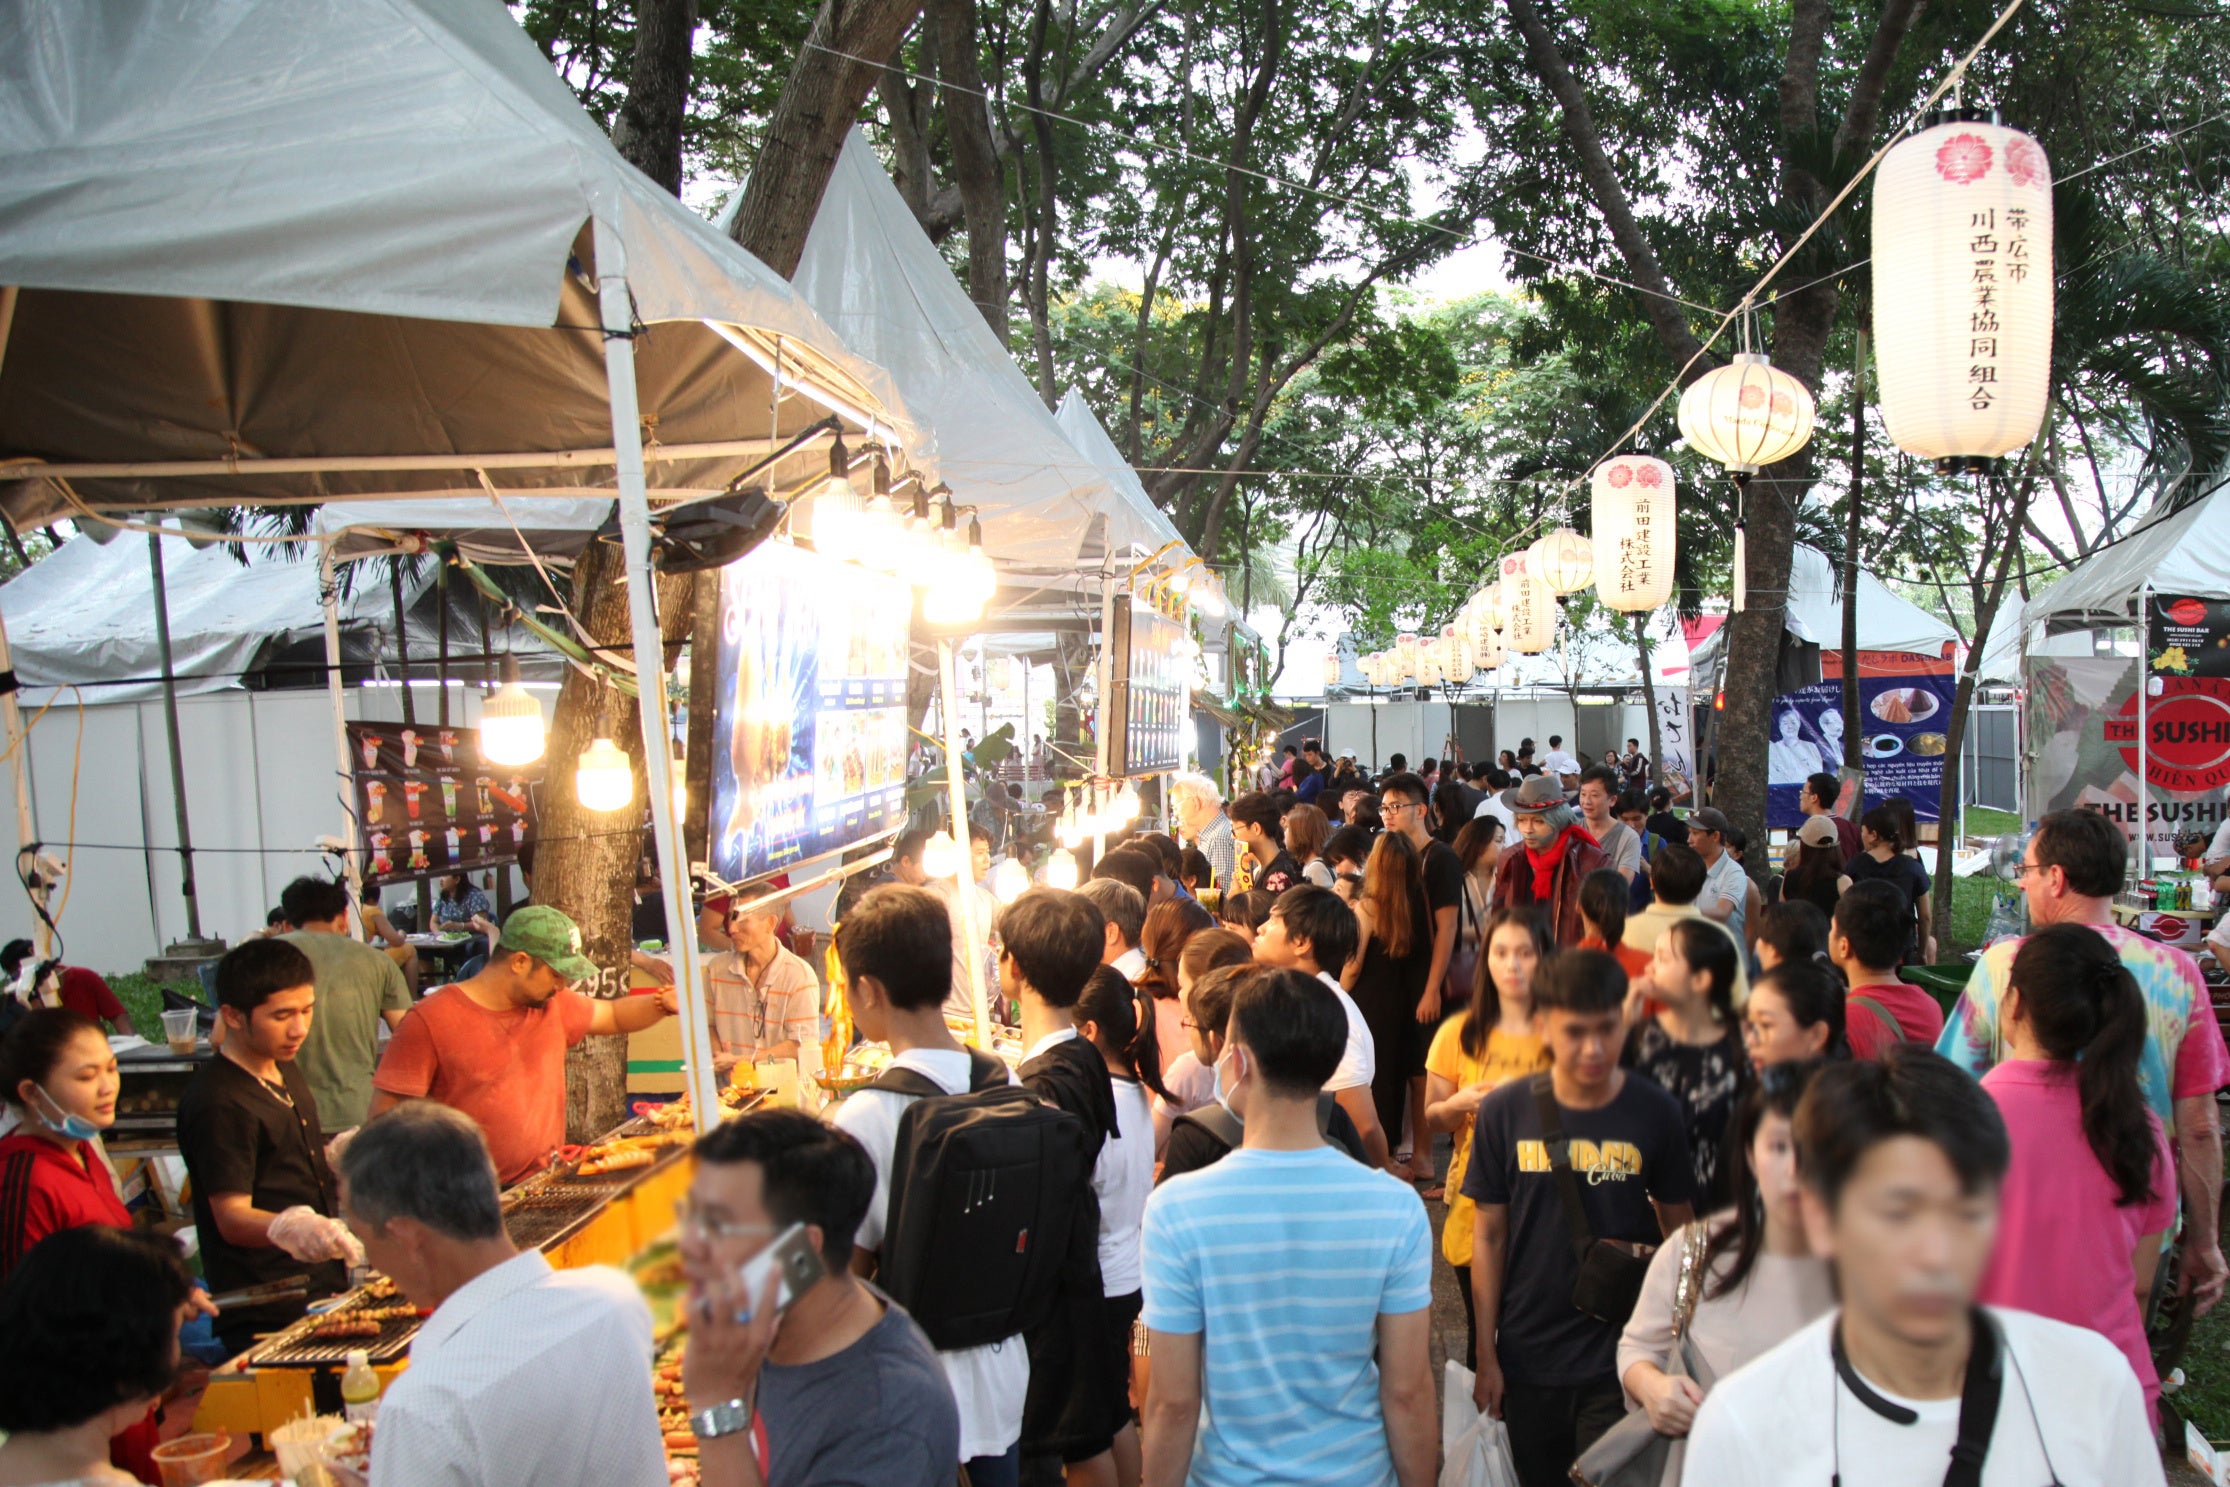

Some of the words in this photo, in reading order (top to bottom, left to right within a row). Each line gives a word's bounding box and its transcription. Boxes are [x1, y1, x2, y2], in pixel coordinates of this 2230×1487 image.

[1969, 207, 1999, 410] 川西農業協同組合
[1636, 498, 1652, 585] 前田建設工業
[1620, 537, 1635, 593] 株式会社
[2110, 724, 2136, 738] TH
[2152, 721, 2230, 743] SUSHI
[2148, 763, 2196, 786] HIÊN
[2147, 802, 2227, 823] SUSHI
[1586, 1161, 1627, 1186] Cuba
